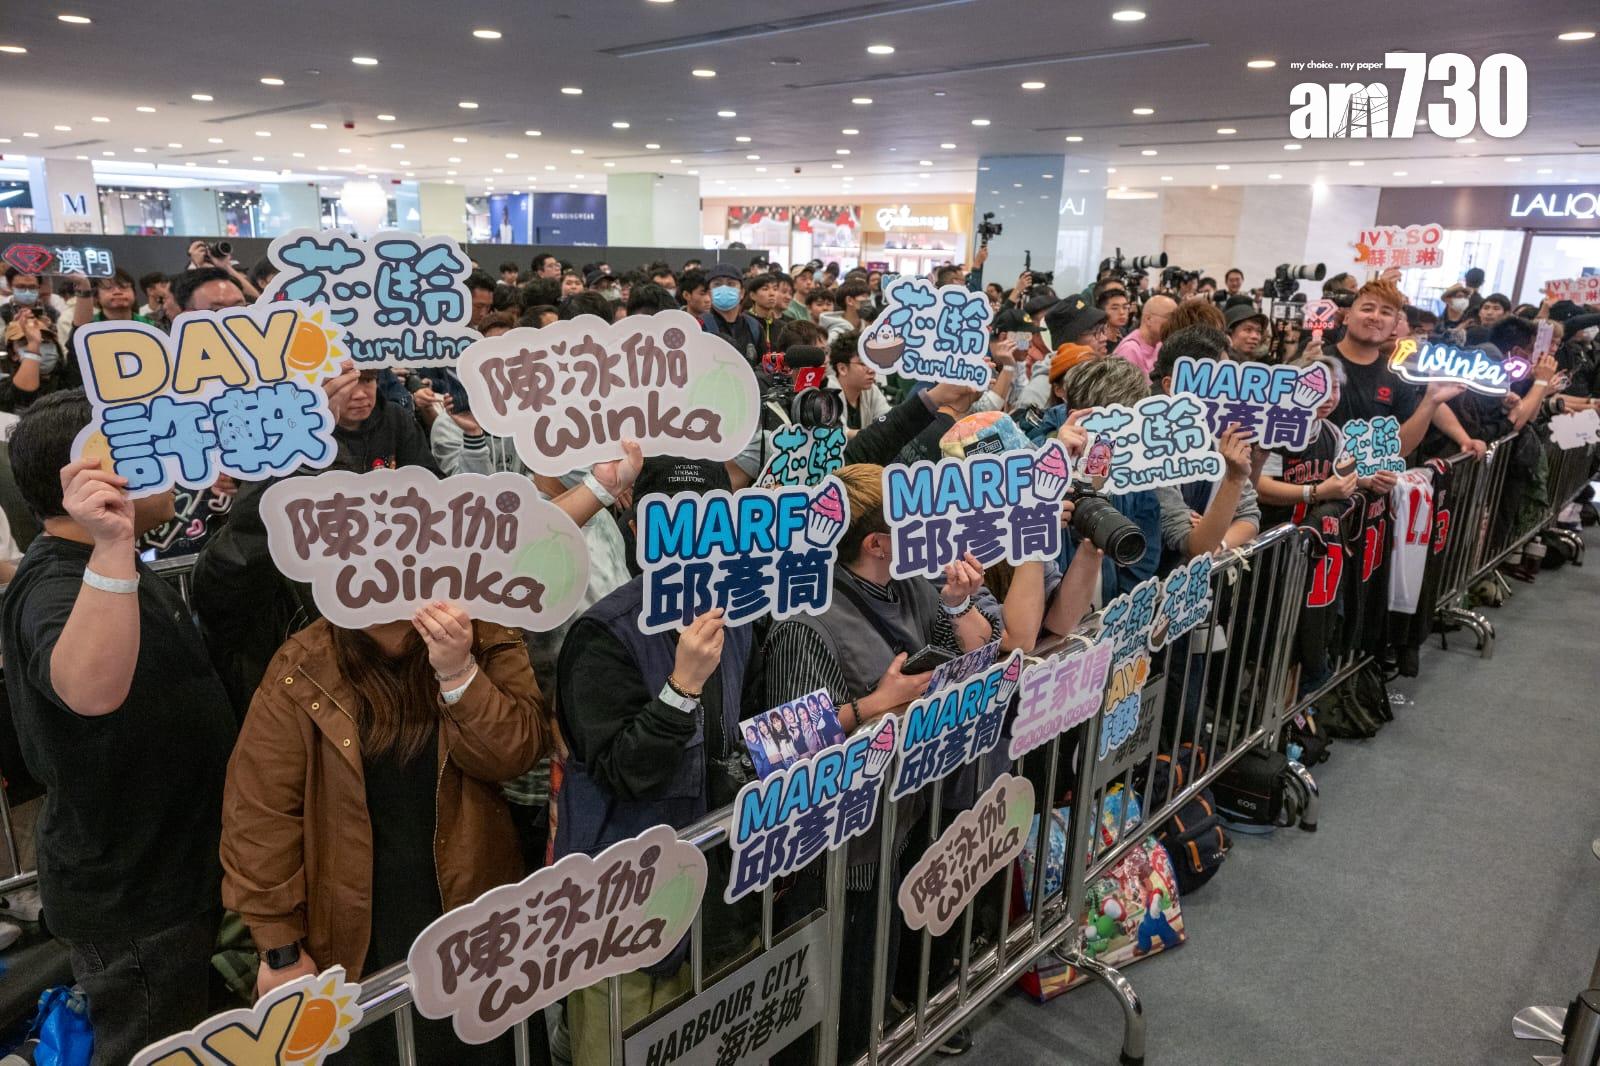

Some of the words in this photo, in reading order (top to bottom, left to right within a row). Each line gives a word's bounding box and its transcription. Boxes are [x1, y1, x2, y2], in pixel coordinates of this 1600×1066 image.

[1511, 192, 1600, 219] LALIQ
[55, 247, 113, 275] 澳門
[1360, 230, 1396, 247] IVY
[1407, 228, 1440, 244] SO
[84, 308, 300, 403] DAY
[342, 327, 478, 362] umLin
[902, 349, 988, 386] SumLing
[1174, 360, 1298, 404] MARF
[889, 455, 1035, 522] MARF
[1112, 457, 1220, 488] SumLing
[644, 492, 812, 564] MARF
[903, 670, 1002, 751] MARF
[1016, 643, 1111, 730] 王家晴
[1106, 657, 1142, 712] AY
[737, 735, 871, 844] MARF
[1237, 799, 1257, 810] EOS
[646, 981, 756, 1066] HARBOUR
[762, 944, 810, 1000] CITY
[715, 976, 810, 1066] 海港城
